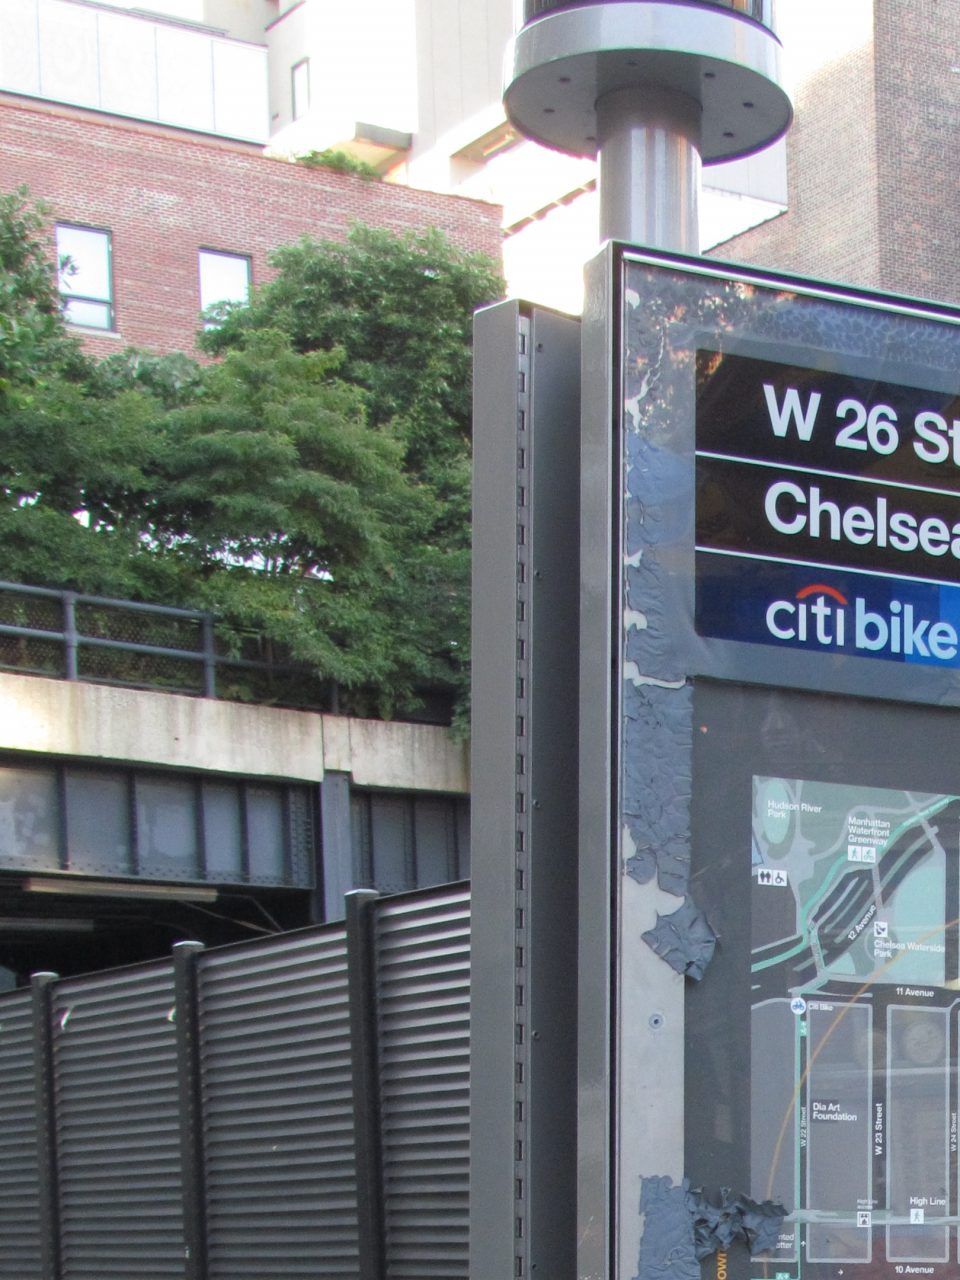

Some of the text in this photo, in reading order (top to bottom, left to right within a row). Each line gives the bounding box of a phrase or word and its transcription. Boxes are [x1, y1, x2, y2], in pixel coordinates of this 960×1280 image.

[762, 384, 820, 441] W
[835, 399, 899, 456] 26
[765, 588, 958, 660] citi bike
[767, 799, 822, 814] Hudson River
[767, 809, 787, 819] Park
[848, 817, 891, 829] Manhattan
[848, 826, 890, 838] Waterfront
[848, 835, 889, 848] Greenway
[847, 904, 877, 941] 12 Avenue
[873, 939, 946, 953] Chelsea Waterside
[873, 948, 893, 959] Park
[895, 987, 935, 998] 11 Avenue
[812, 1102, 841, 1113] Dia Art
[812, 1111, 858, 1122] Foundation
[875, 1103, 883, 1156] W 23 Street
[909, 1197, 947, 1208] High Line
[895, 1266, 934, 1275] 10 Avenue
